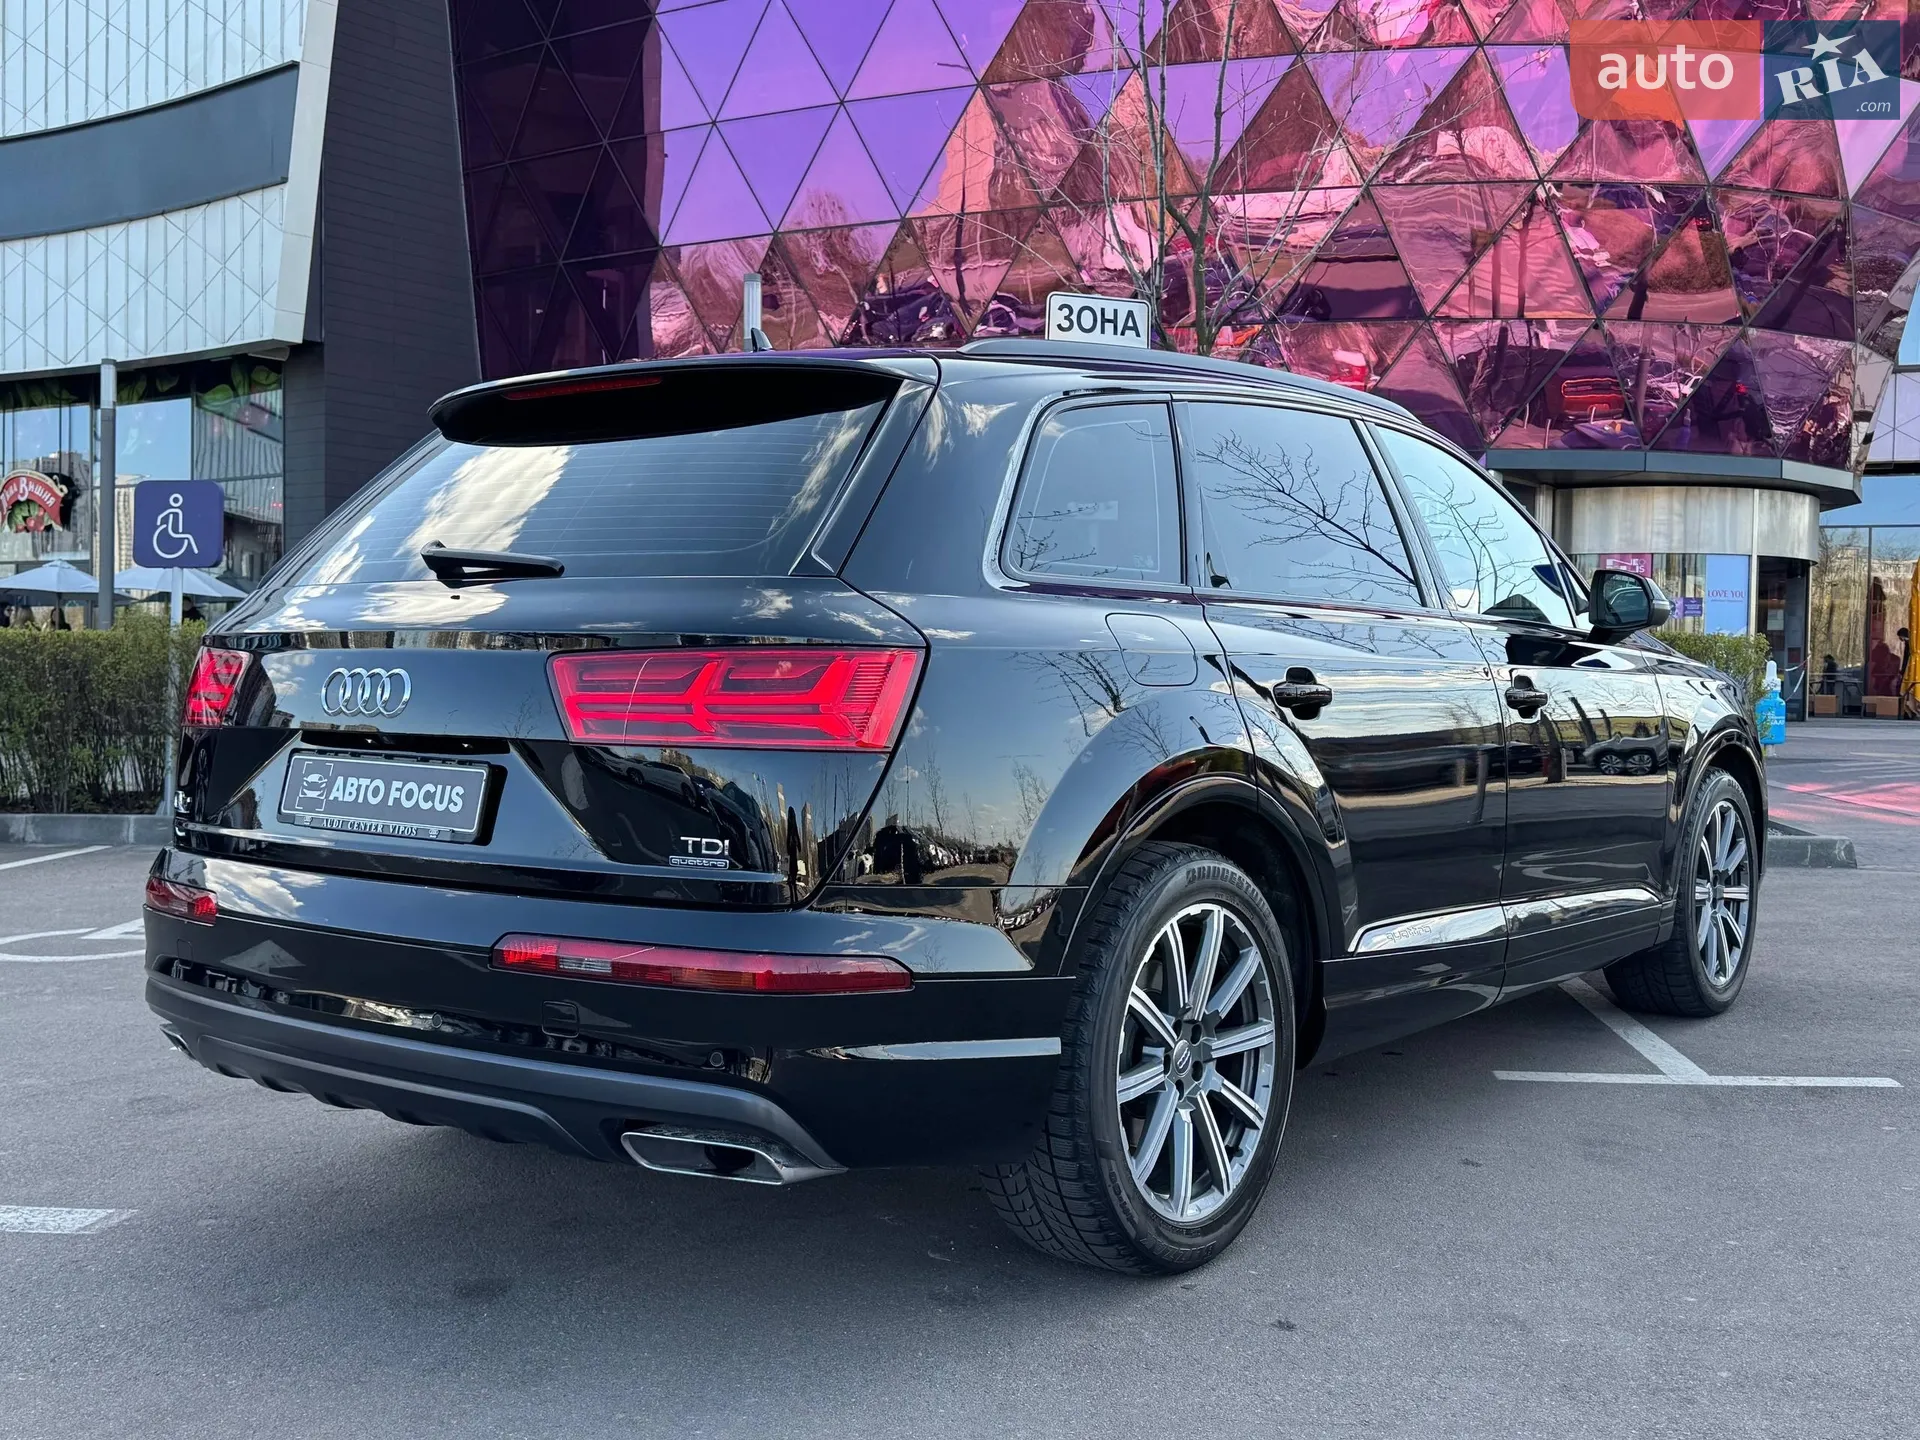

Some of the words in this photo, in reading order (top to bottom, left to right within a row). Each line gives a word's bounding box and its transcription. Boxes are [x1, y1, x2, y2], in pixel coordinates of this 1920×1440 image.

[1056, 303, 1142, 338] ЗОНА
[1707, 589, 1728, 598] LOVE
[387, 780, 465, 813] FOCUS
[322, 818, 344, 829] AUDI
[347, 820, 385, 833] CENTER
[389, 824, 418, 836] VIPOS
[680, 836, 729, 855] TDI
[671, 858, 726, 867] quattro
